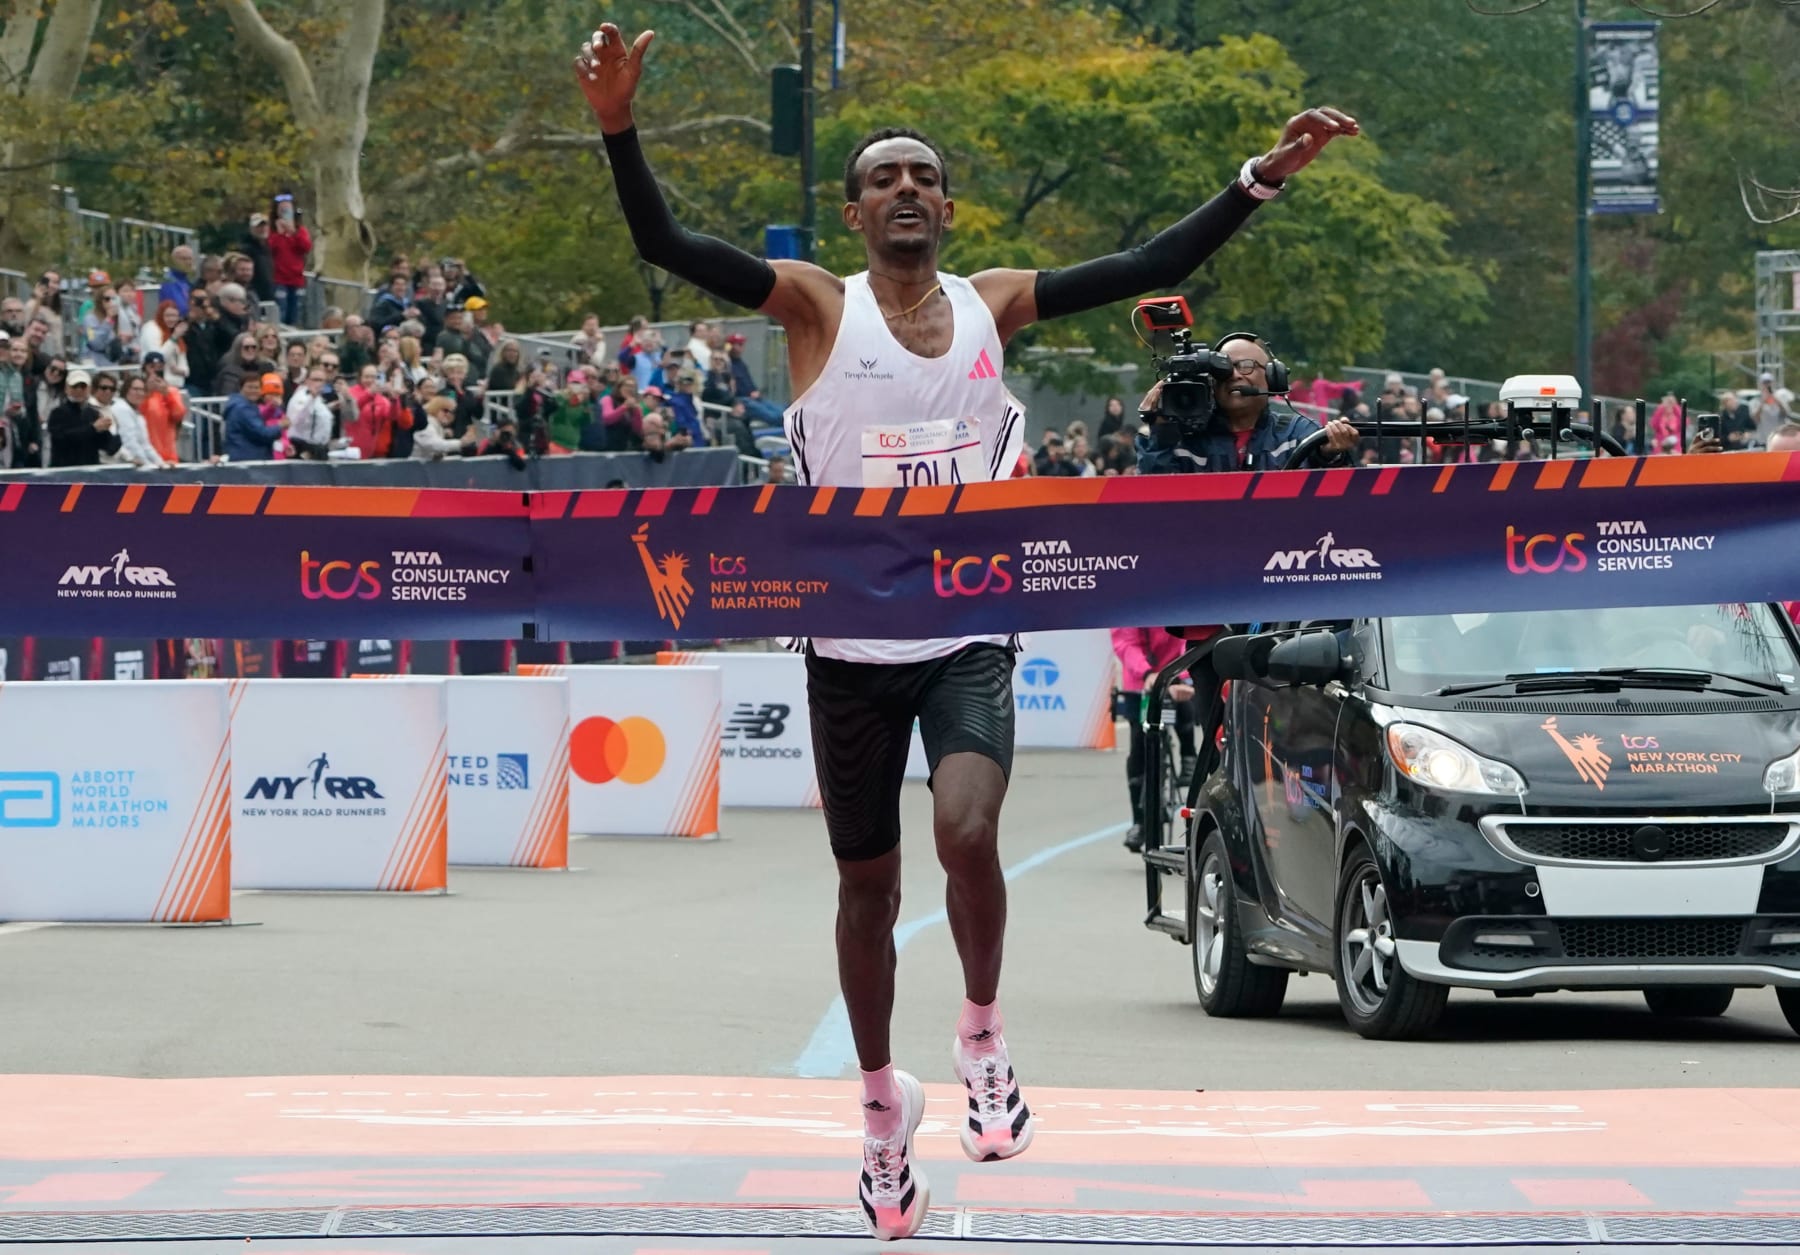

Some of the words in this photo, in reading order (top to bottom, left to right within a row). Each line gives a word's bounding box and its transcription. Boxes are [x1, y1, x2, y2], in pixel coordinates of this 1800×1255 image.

[1597, 520, 1647, 535] TATA
[1021, 540, 1072, 556] TATA
[1506, 525, 1588, 574] tcs
[1596, 536, 1715, 553] CONSULTANCY
[391, 551, 443, 565] TATA
[710, 553, 747, 575] tcs
[1022, 555, 1140, 574] CONSULTANCY
[1598, 555, 1673, 572] SERVICES
[301, 550, 382, 600] tcs
[391, 568, 511, 584] CONSULTANCY
[933, 549, 1013, 598] tcs
[1263, 575, 1284, 583] NEW
[1286, 574, 1311, 582] YORK
[1312, 573, 1338, 581] ROAD
[1340, 572, 1382, 581] RUNNERS
[711, 581, 747, 593] NEW
[751, 581, 792, 593] YORK
[795, 582, 829, 593] CITY
[1022, 575, 1097, 592] SERVICES
[57, 590, 79, 598] NEW
[80, 590, 105, 598] YORK
[107, 590, 133, 598] ROAD
[134, 590, 177, 599] RUNNERS
[391, 586, 467, 601] SERVICES
[711, 596, 801, 609] MARATHON
[1016, 694, 1066, 711] TATA
[1618, 733, 1660, 749] tcs
[740, 745, 803, 759] balance
[1626, 752, 1663, 762] NEW
[1665, 752, 1707, 762] YORK
[1709, 753, 1742, 763] CITY
[1630, 763, 1718, 774] MARATHON
[72, 770, 135, 783] ABBOTT
[71, 785, 130, 798] WORLD
[72, 800, 168, 813] MARATHON
[242, 808, 267, 817] NEW
[270, 808, 299, 817] YORK
[302, 808, 333, 817] ROAD
[336, 807, 387, 817] RUNNERS
[72, 815, 140, 829] MAJORS
